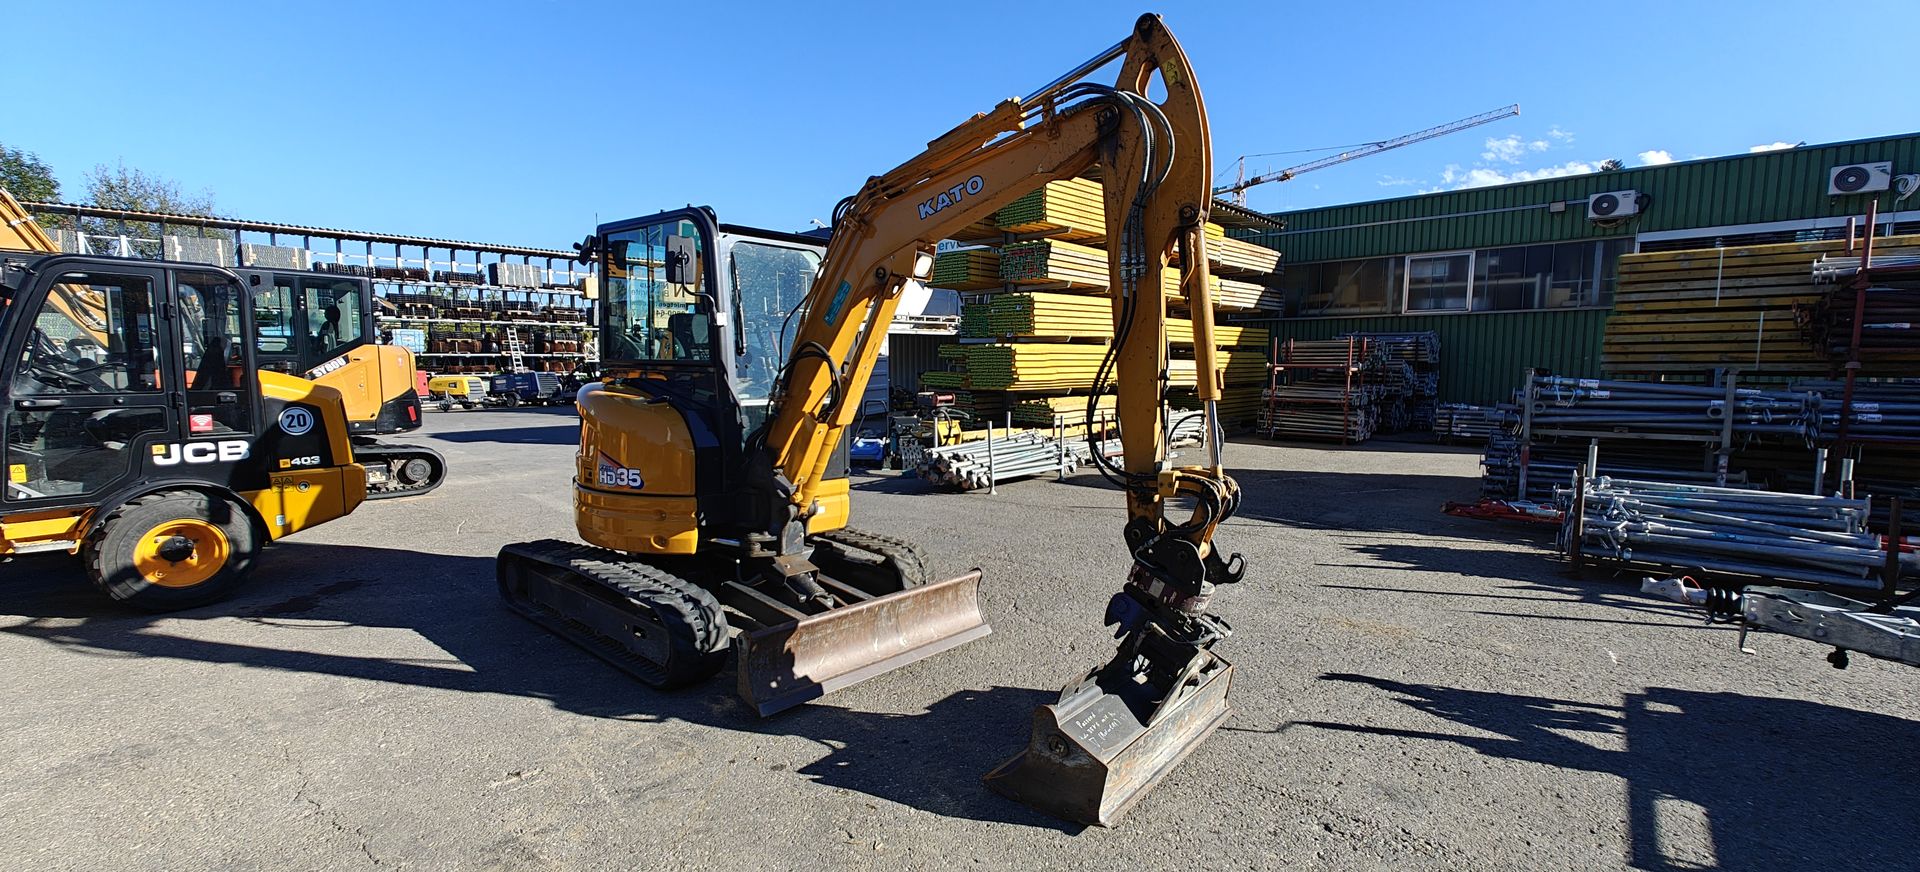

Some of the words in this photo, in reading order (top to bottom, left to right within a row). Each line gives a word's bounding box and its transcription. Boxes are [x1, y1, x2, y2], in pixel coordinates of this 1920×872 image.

[918, 175, 984, 220] KATO
[286, 414, 307, 428] 20
[153, 440, 249, 465] JCB
[291, 456, 320, 465] 403
[600, 468, 642, 487] HD35
